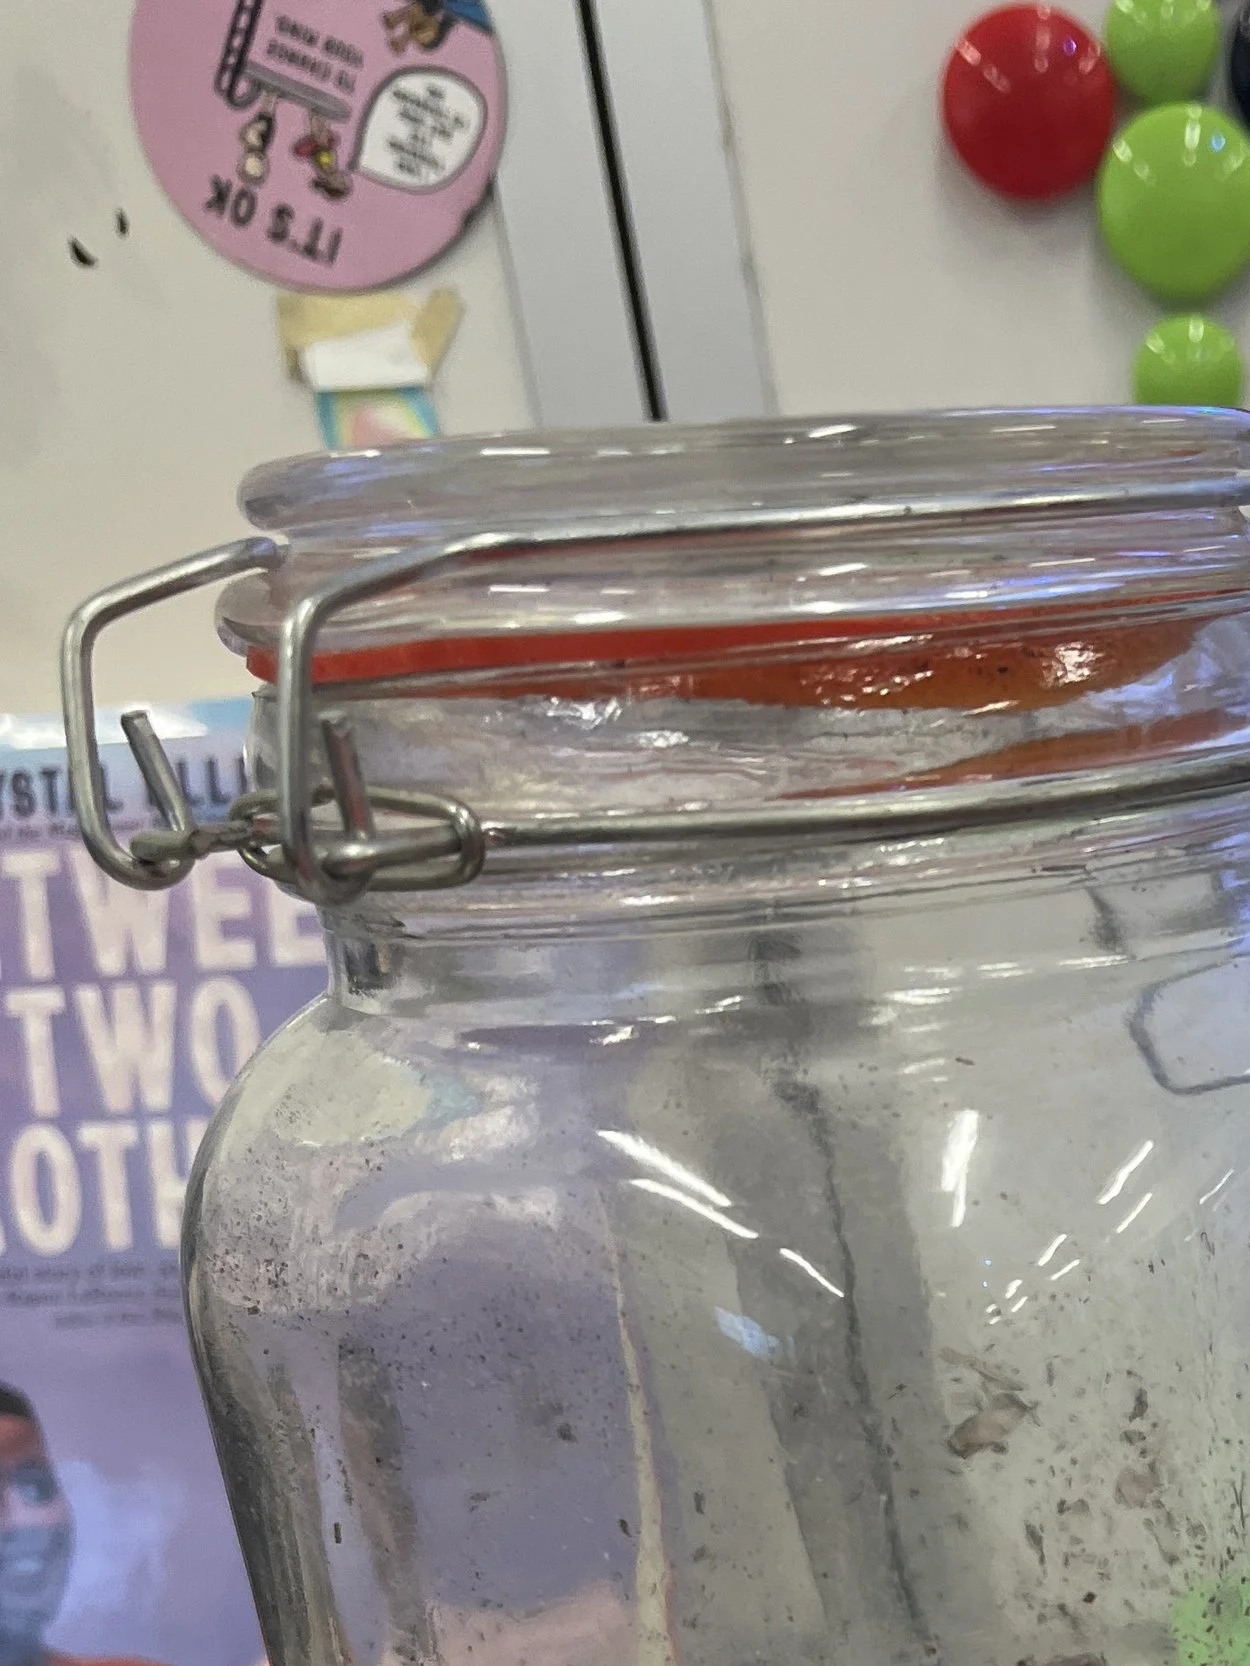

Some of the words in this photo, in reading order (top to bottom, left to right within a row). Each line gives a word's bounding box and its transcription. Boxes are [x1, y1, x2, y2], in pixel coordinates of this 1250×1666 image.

[205, 174, 258, 227] OK
[267, 204, 343, 268] IT'S
[5, 976, 262, 1117] TWO
